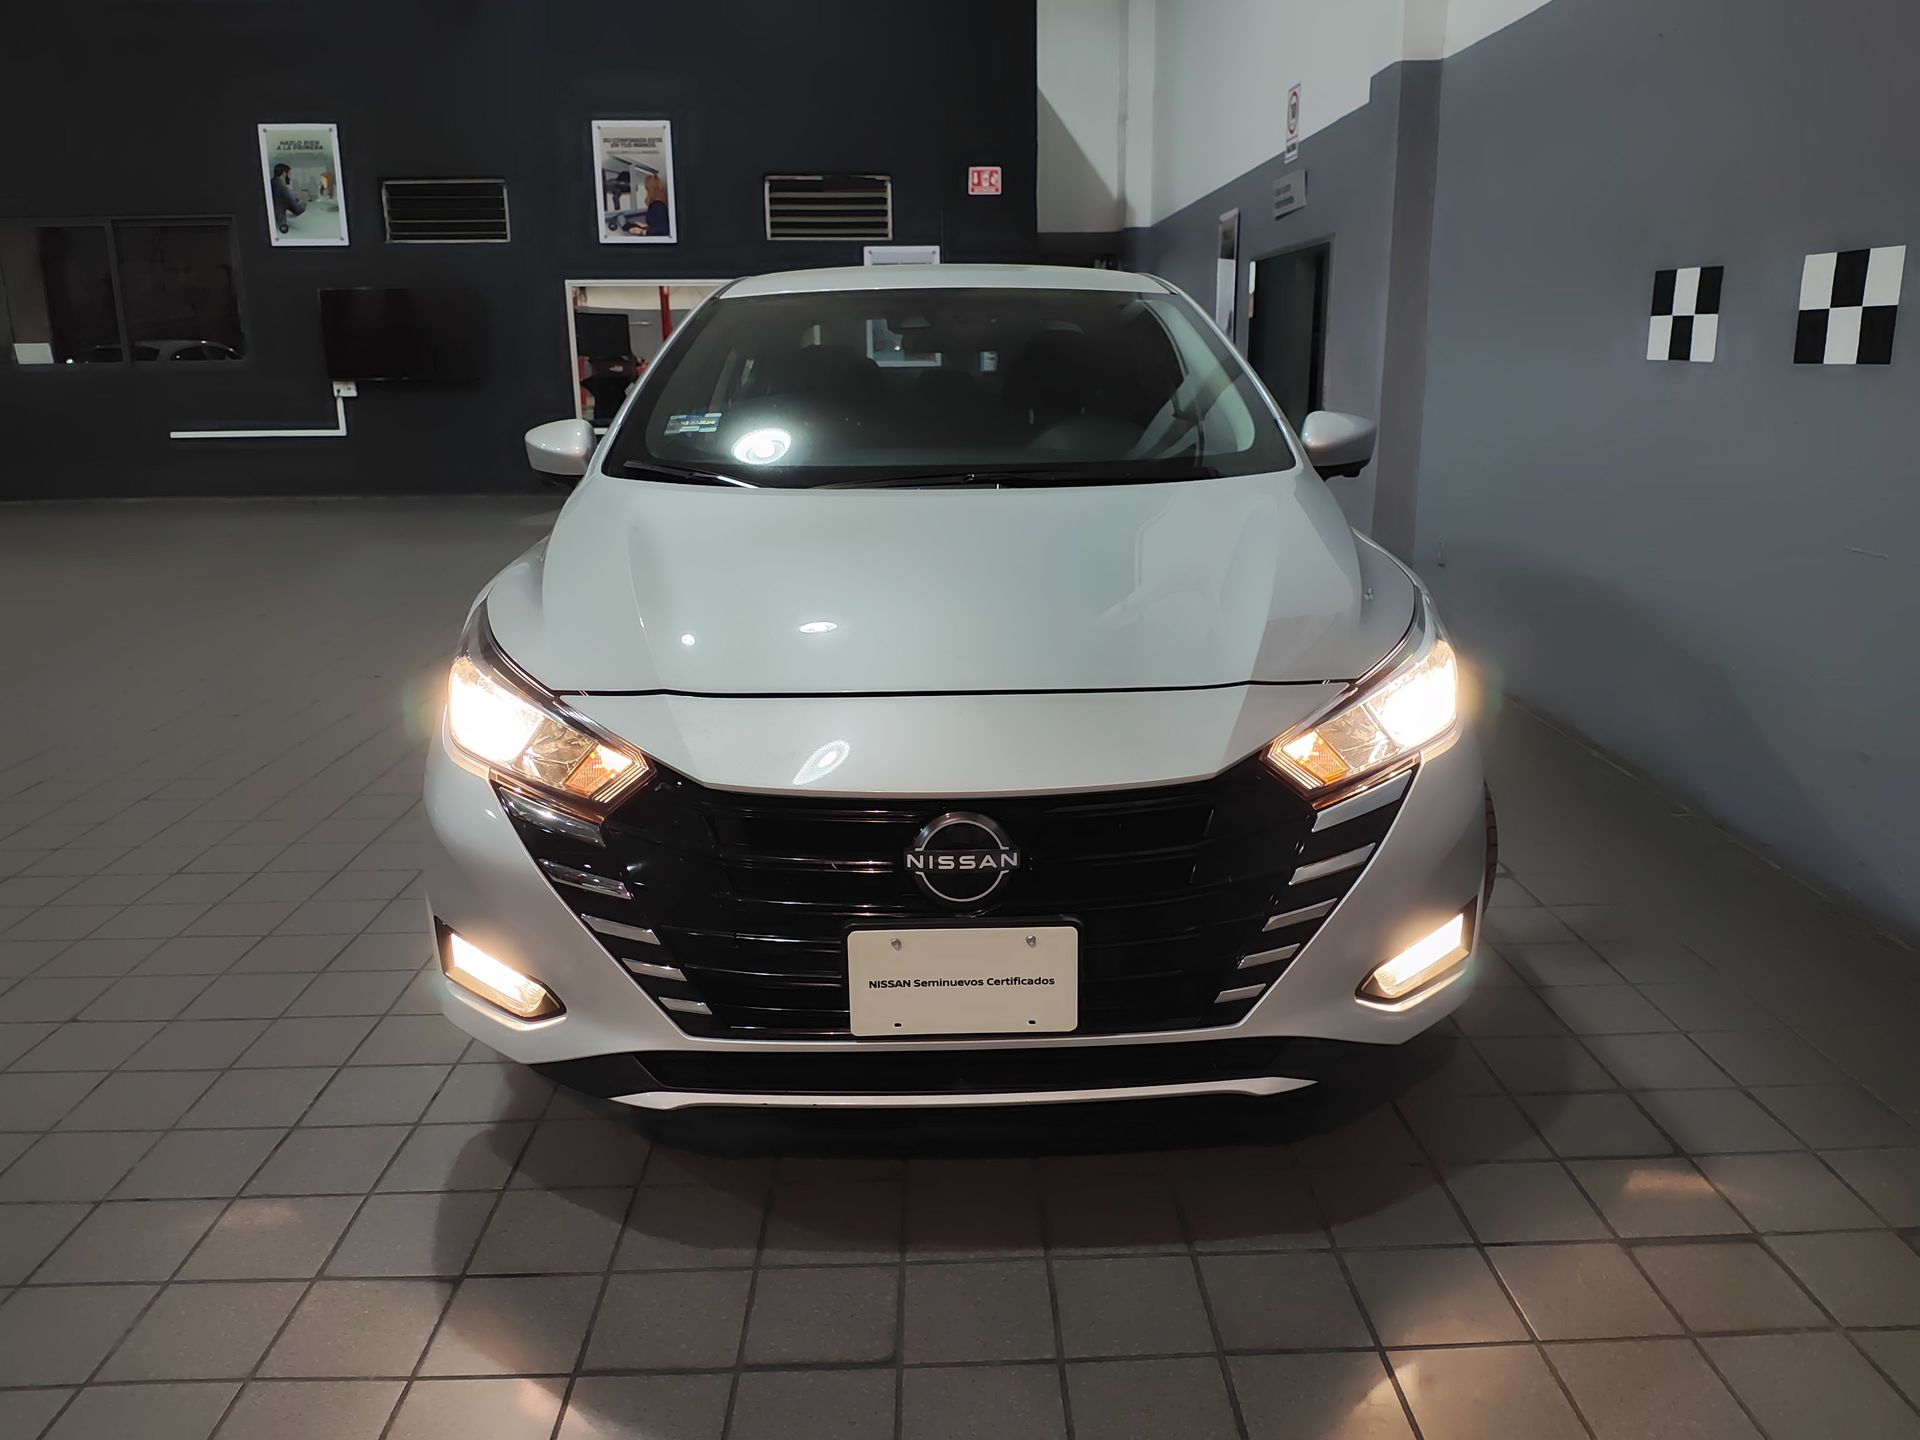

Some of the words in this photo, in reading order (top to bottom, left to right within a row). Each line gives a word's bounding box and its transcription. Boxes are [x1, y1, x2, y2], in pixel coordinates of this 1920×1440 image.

[906, 852, 1018, 869] NISSAN
[868, 979, 911, 989] NISSAN
[913, 978, 984, 988] Seminuevos
[986, 976, 1055, 986] Certificados
